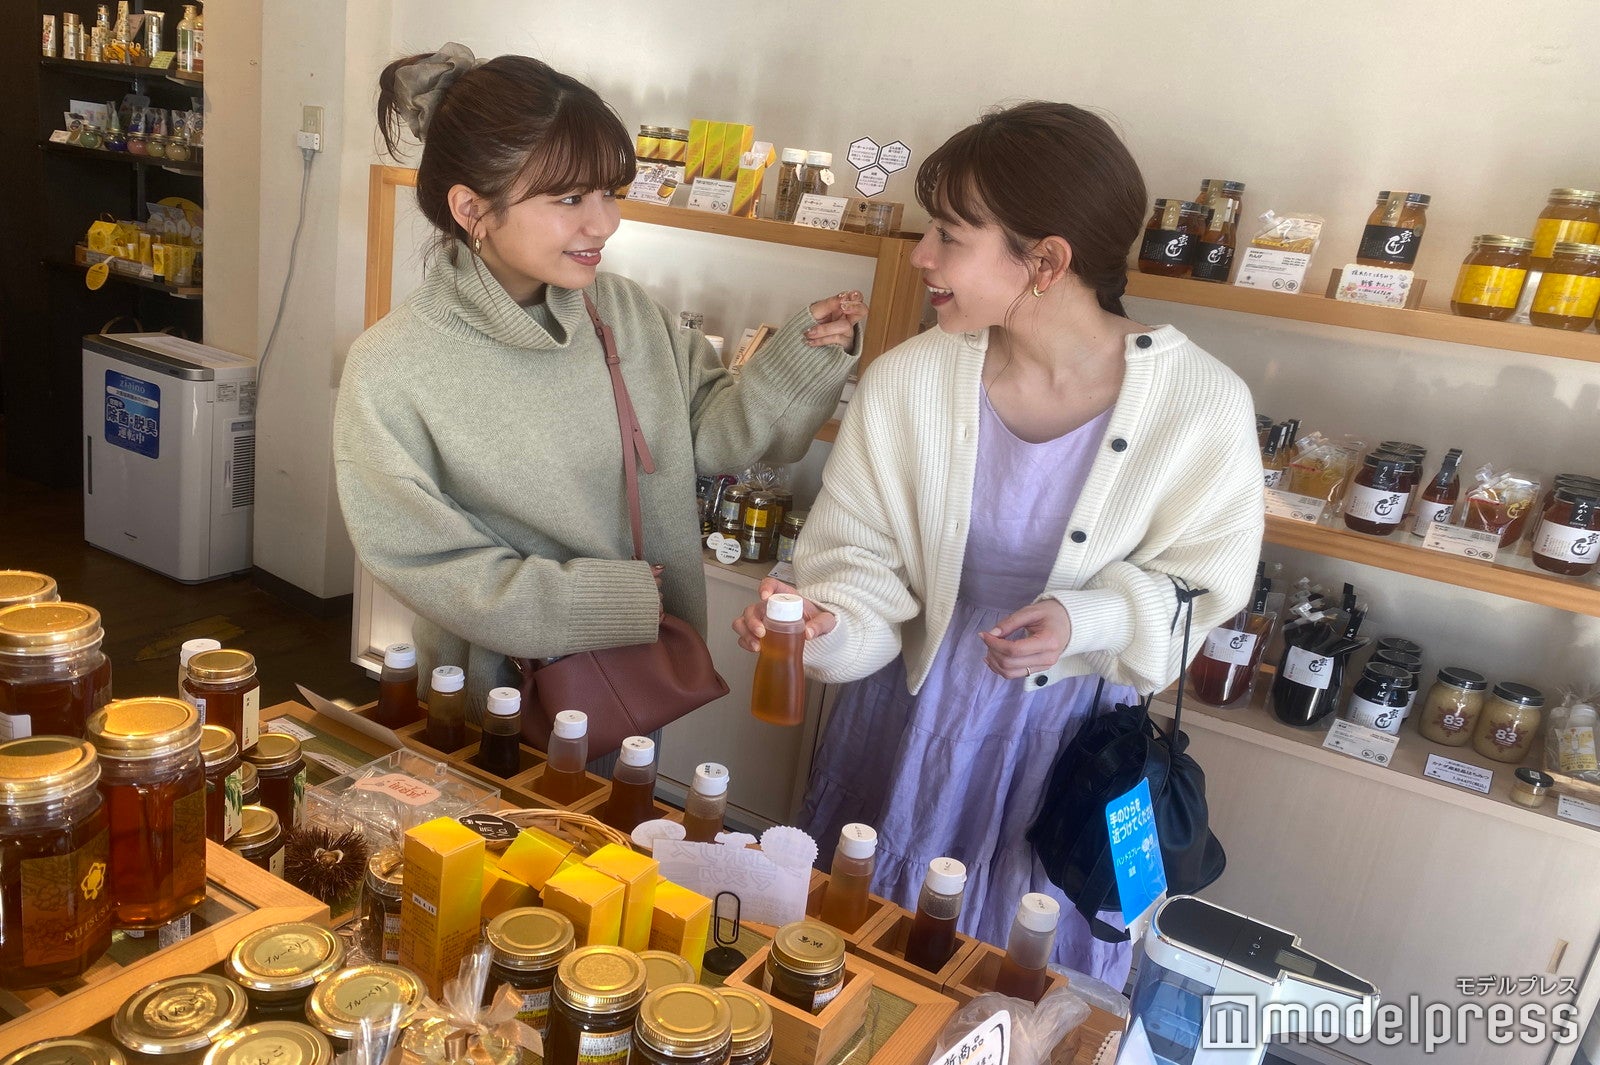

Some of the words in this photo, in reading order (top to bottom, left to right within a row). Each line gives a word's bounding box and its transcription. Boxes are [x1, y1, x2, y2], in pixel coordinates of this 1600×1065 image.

[117, 426, 145, 444] 運転中
[1576, 502, 1589, 522] みかん
[1443, 714, 1465, 728] 83
[1495, 729, 1518, 743] 83
[1109, 797, 1142, 828] 手のひらを
[264, 938, 310, 965] ブルーベリー
[345, 981, 391, 1011] ブルーベリー
